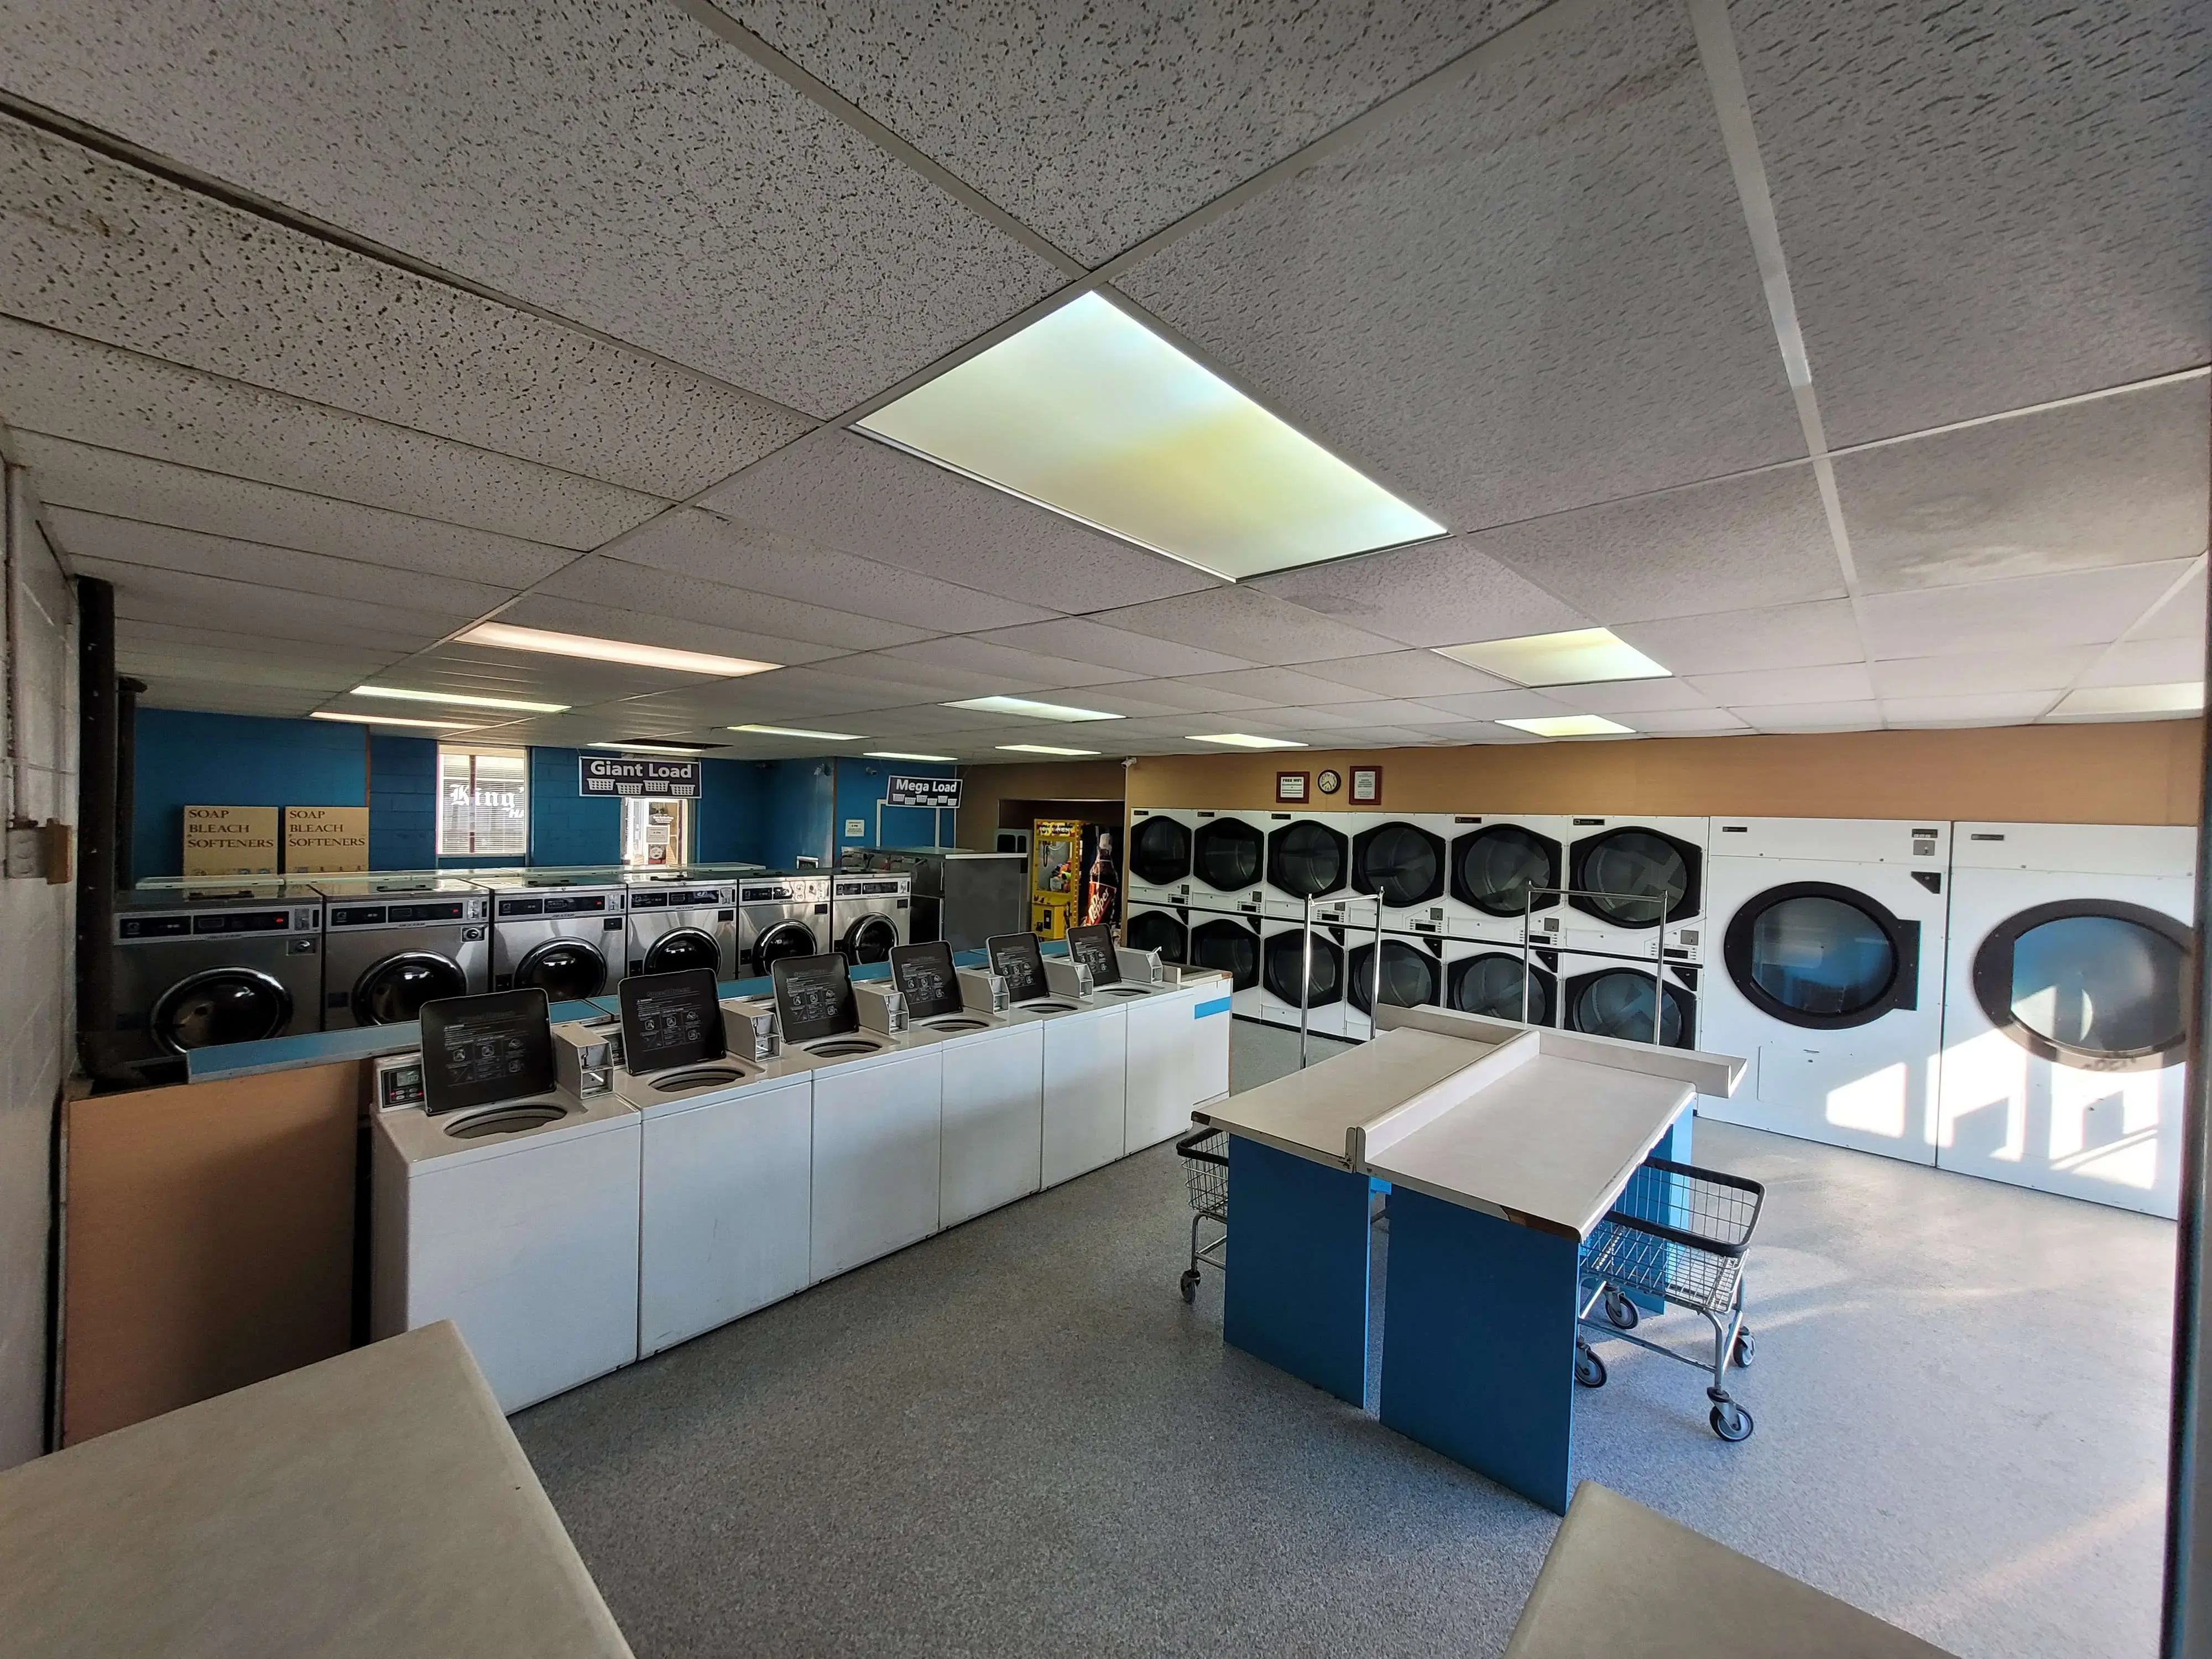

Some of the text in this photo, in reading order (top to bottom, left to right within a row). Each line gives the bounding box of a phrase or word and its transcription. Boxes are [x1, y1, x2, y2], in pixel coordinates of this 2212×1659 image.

[590, 760, 691, 778] Giant Load
[896, 779, 957, 794] Mega Load
[189, 810, 229, 819] SOAP
[289, 810, 325, 819] SOAP
[189, 824, 249, 833] BLEACH
[289, 824, 343, 832] BLEACH
[187, 839, 274, 848] SOFTENERS
[289, 838, 366, 847] SOFTENERS
[1088, 887, 1109, 925] Pepper
